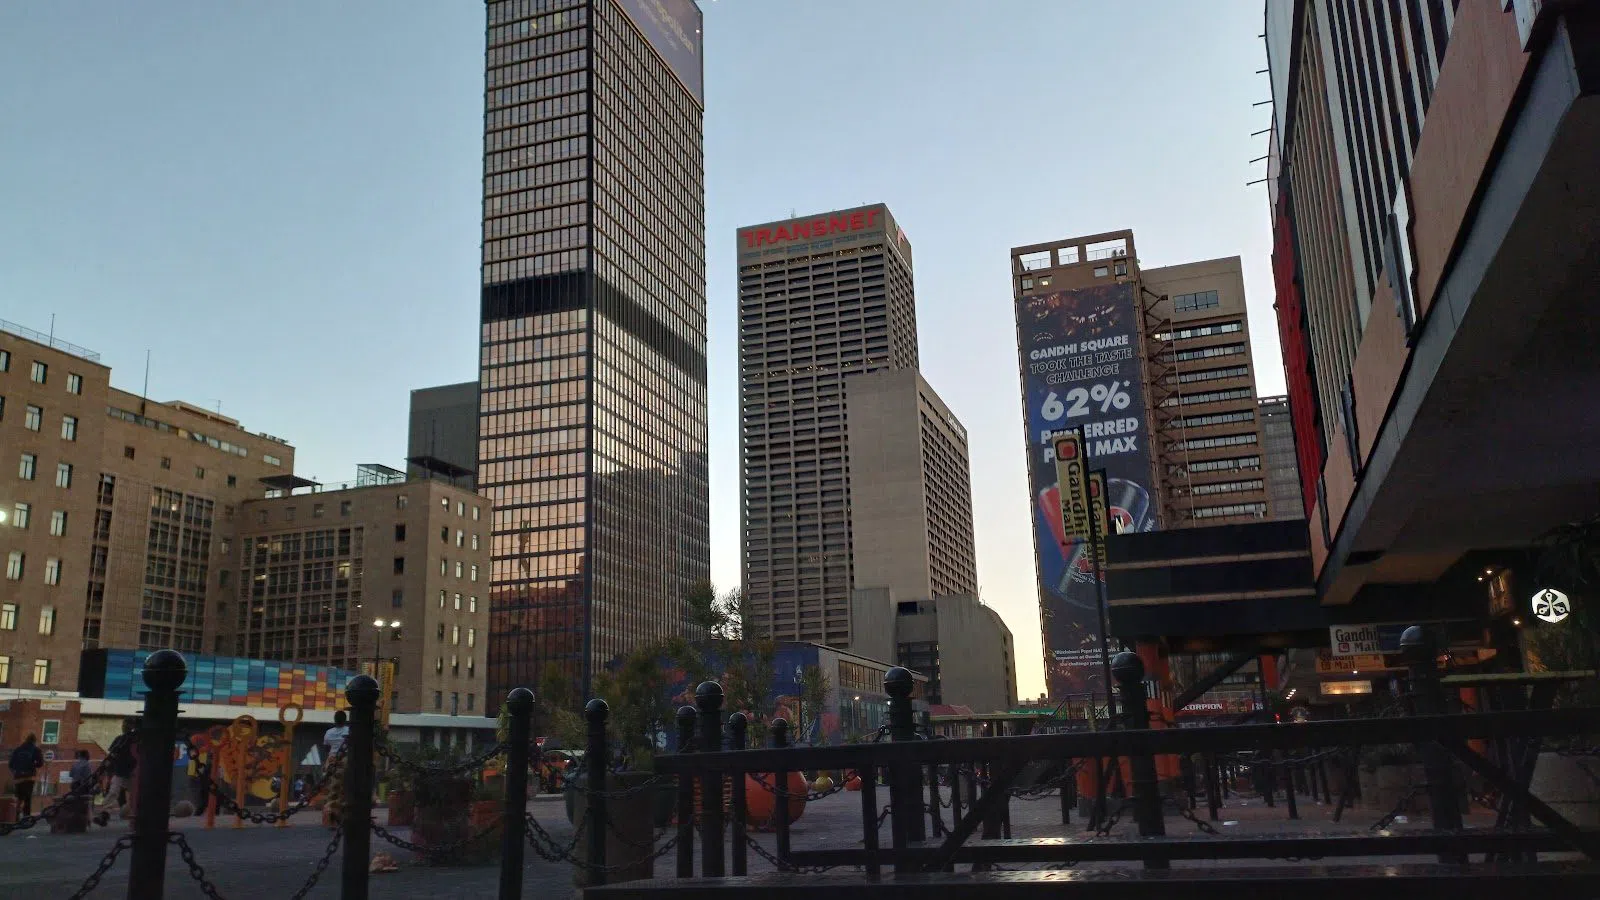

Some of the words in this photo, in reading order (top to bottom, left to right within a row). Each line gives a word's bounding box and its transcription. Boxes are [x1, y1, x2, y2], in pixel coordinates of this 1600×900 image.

[739, 208, 881, 248] TRANSNET
[1030, 343, 1077, 360] GANDHI
[1080, 334, 1129, 352] SQUARE
[1030, 358, 1067, 375] TOOK
[1069, 354, 1093, 368] THE
[1095, 347, 1133, 364] TASTE
[1046, 363, 1120, 385] CHALLENGE
[1095, 435, 1138, 456] MAX
[1068, 462, 1088, 536] Gandhi
[1061, 499, 1074, 537] Mall
[1335, 627, 1378, 643] Gandhi
